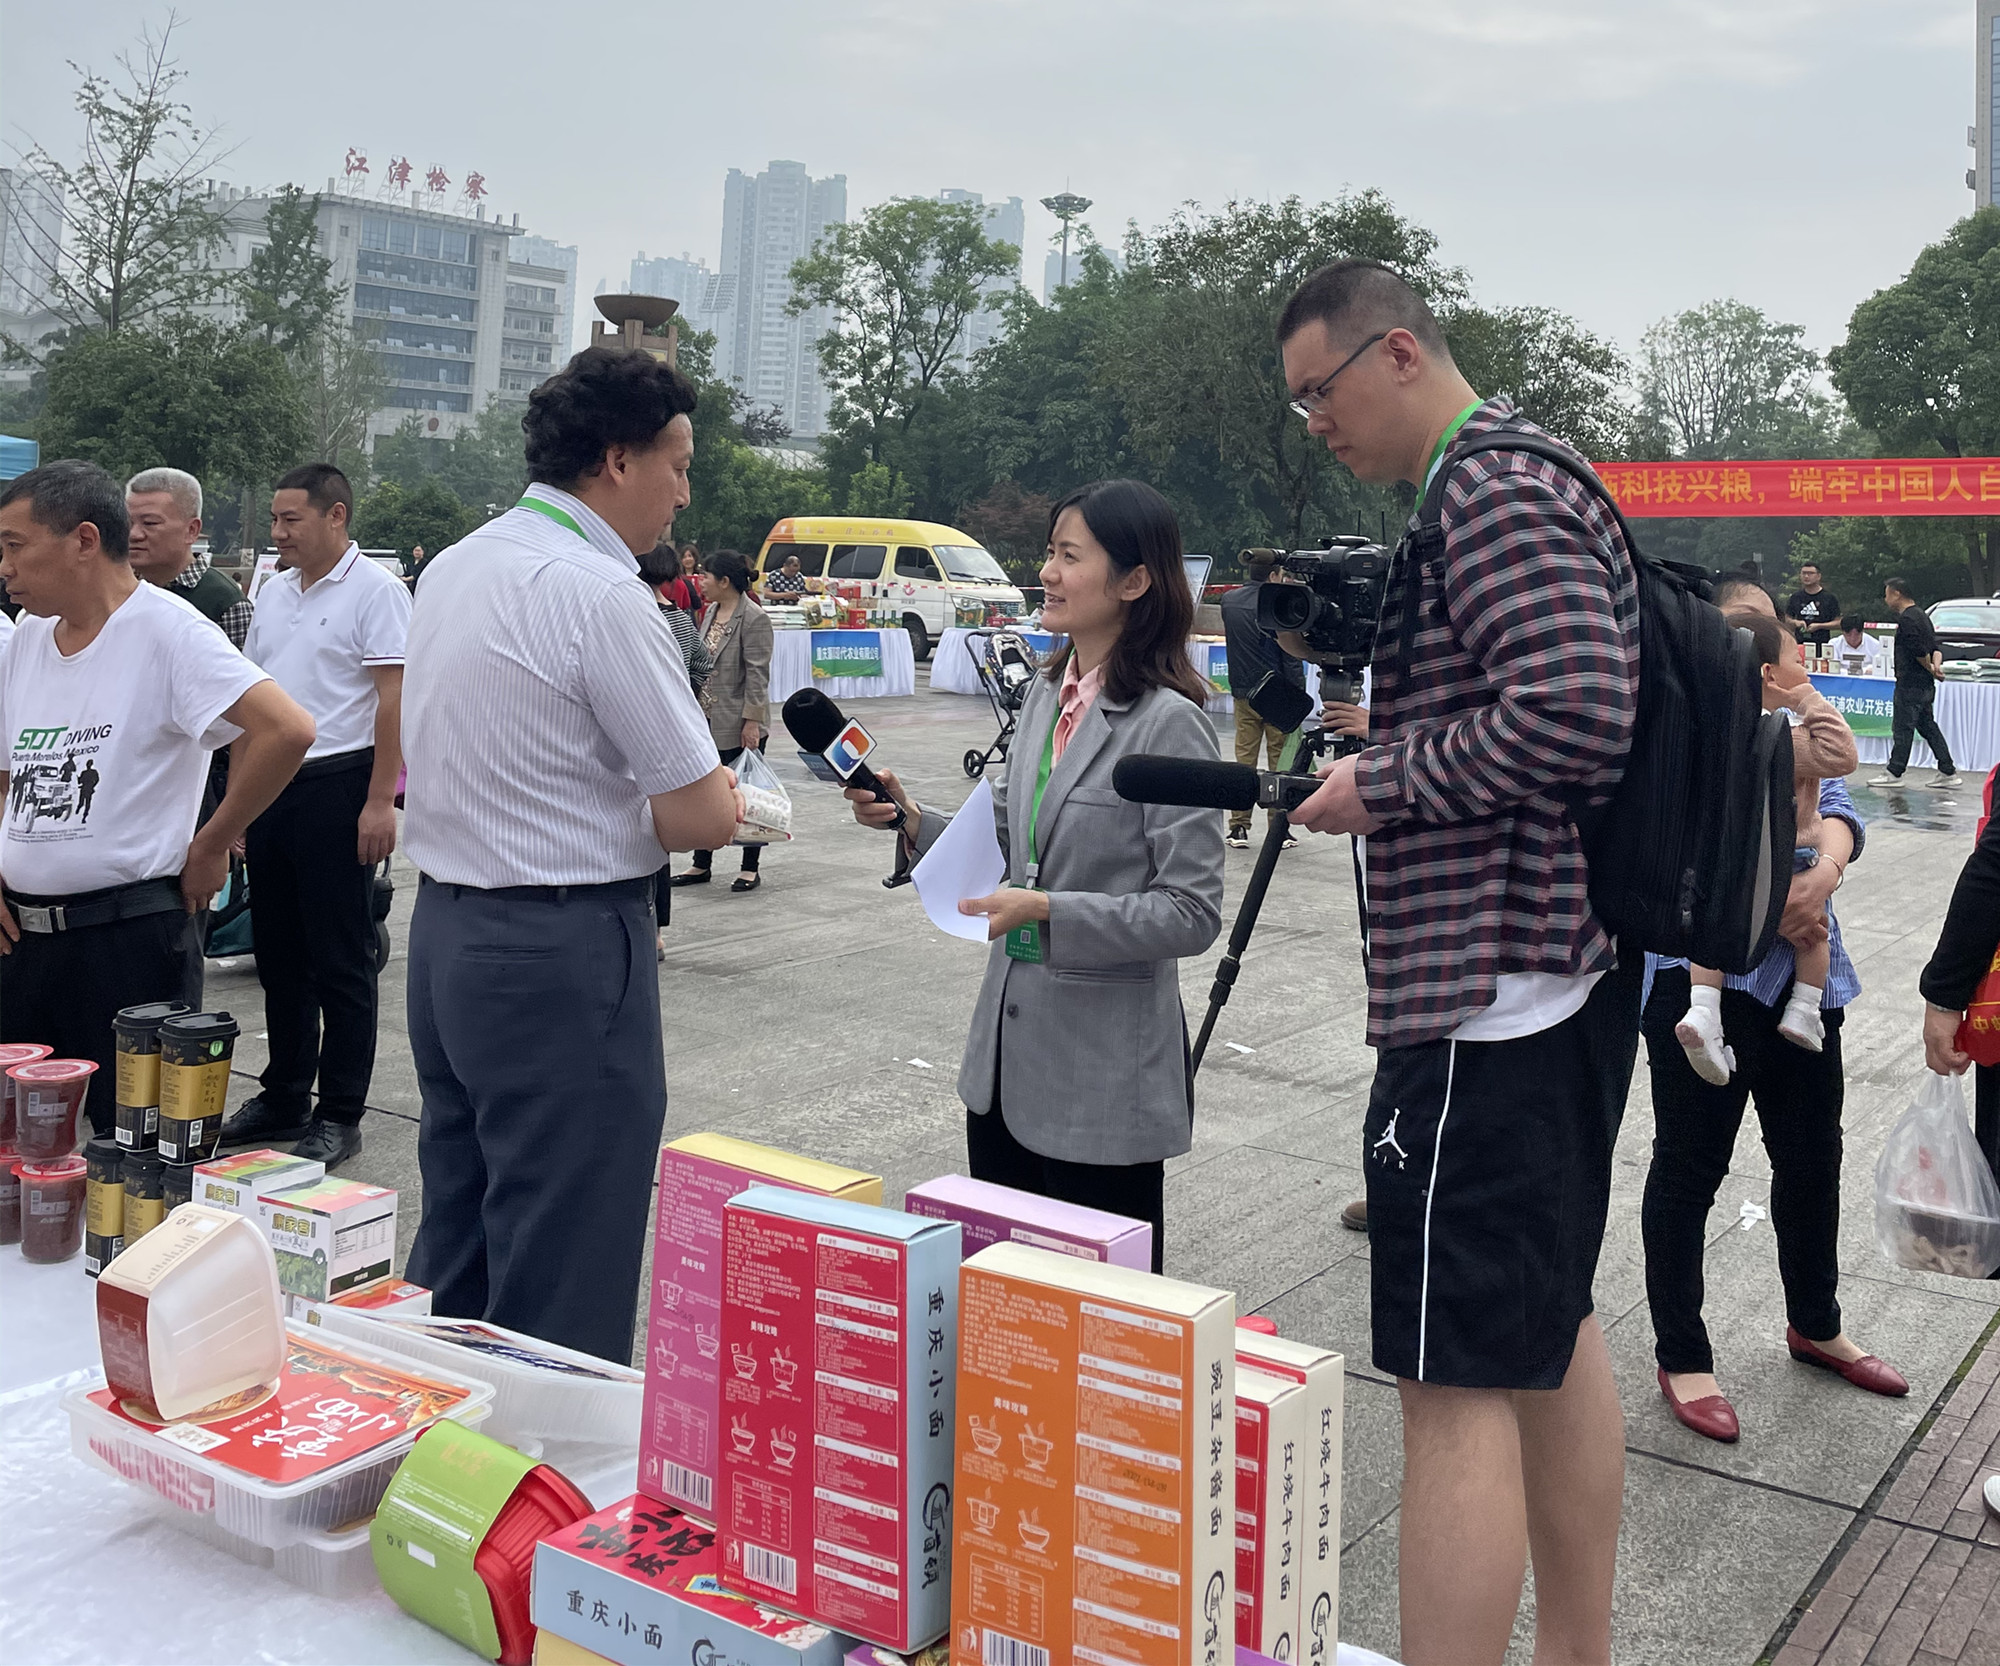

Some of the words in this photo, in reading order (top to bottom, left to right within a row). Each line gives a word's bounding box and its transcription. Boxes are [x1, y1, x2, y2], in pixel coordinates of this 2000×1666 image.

[346, 147, 488, 201] 江津检察
[1800, 609, 1820, 617] adidas
[63, 724, 113, 747] DIVING
[64, 745, 100, 759] Mexico
[1372, 1150, 1405, 1170] AIR
[928, 1285, 944, 1438] 重庆小面
[1319, 1407, 1332, 1561] 红烧牛肉面
[1280, 1440, 1294, 1600] 红烧牛肉面
[566, 1589, 664, 1650] 重庆小面
